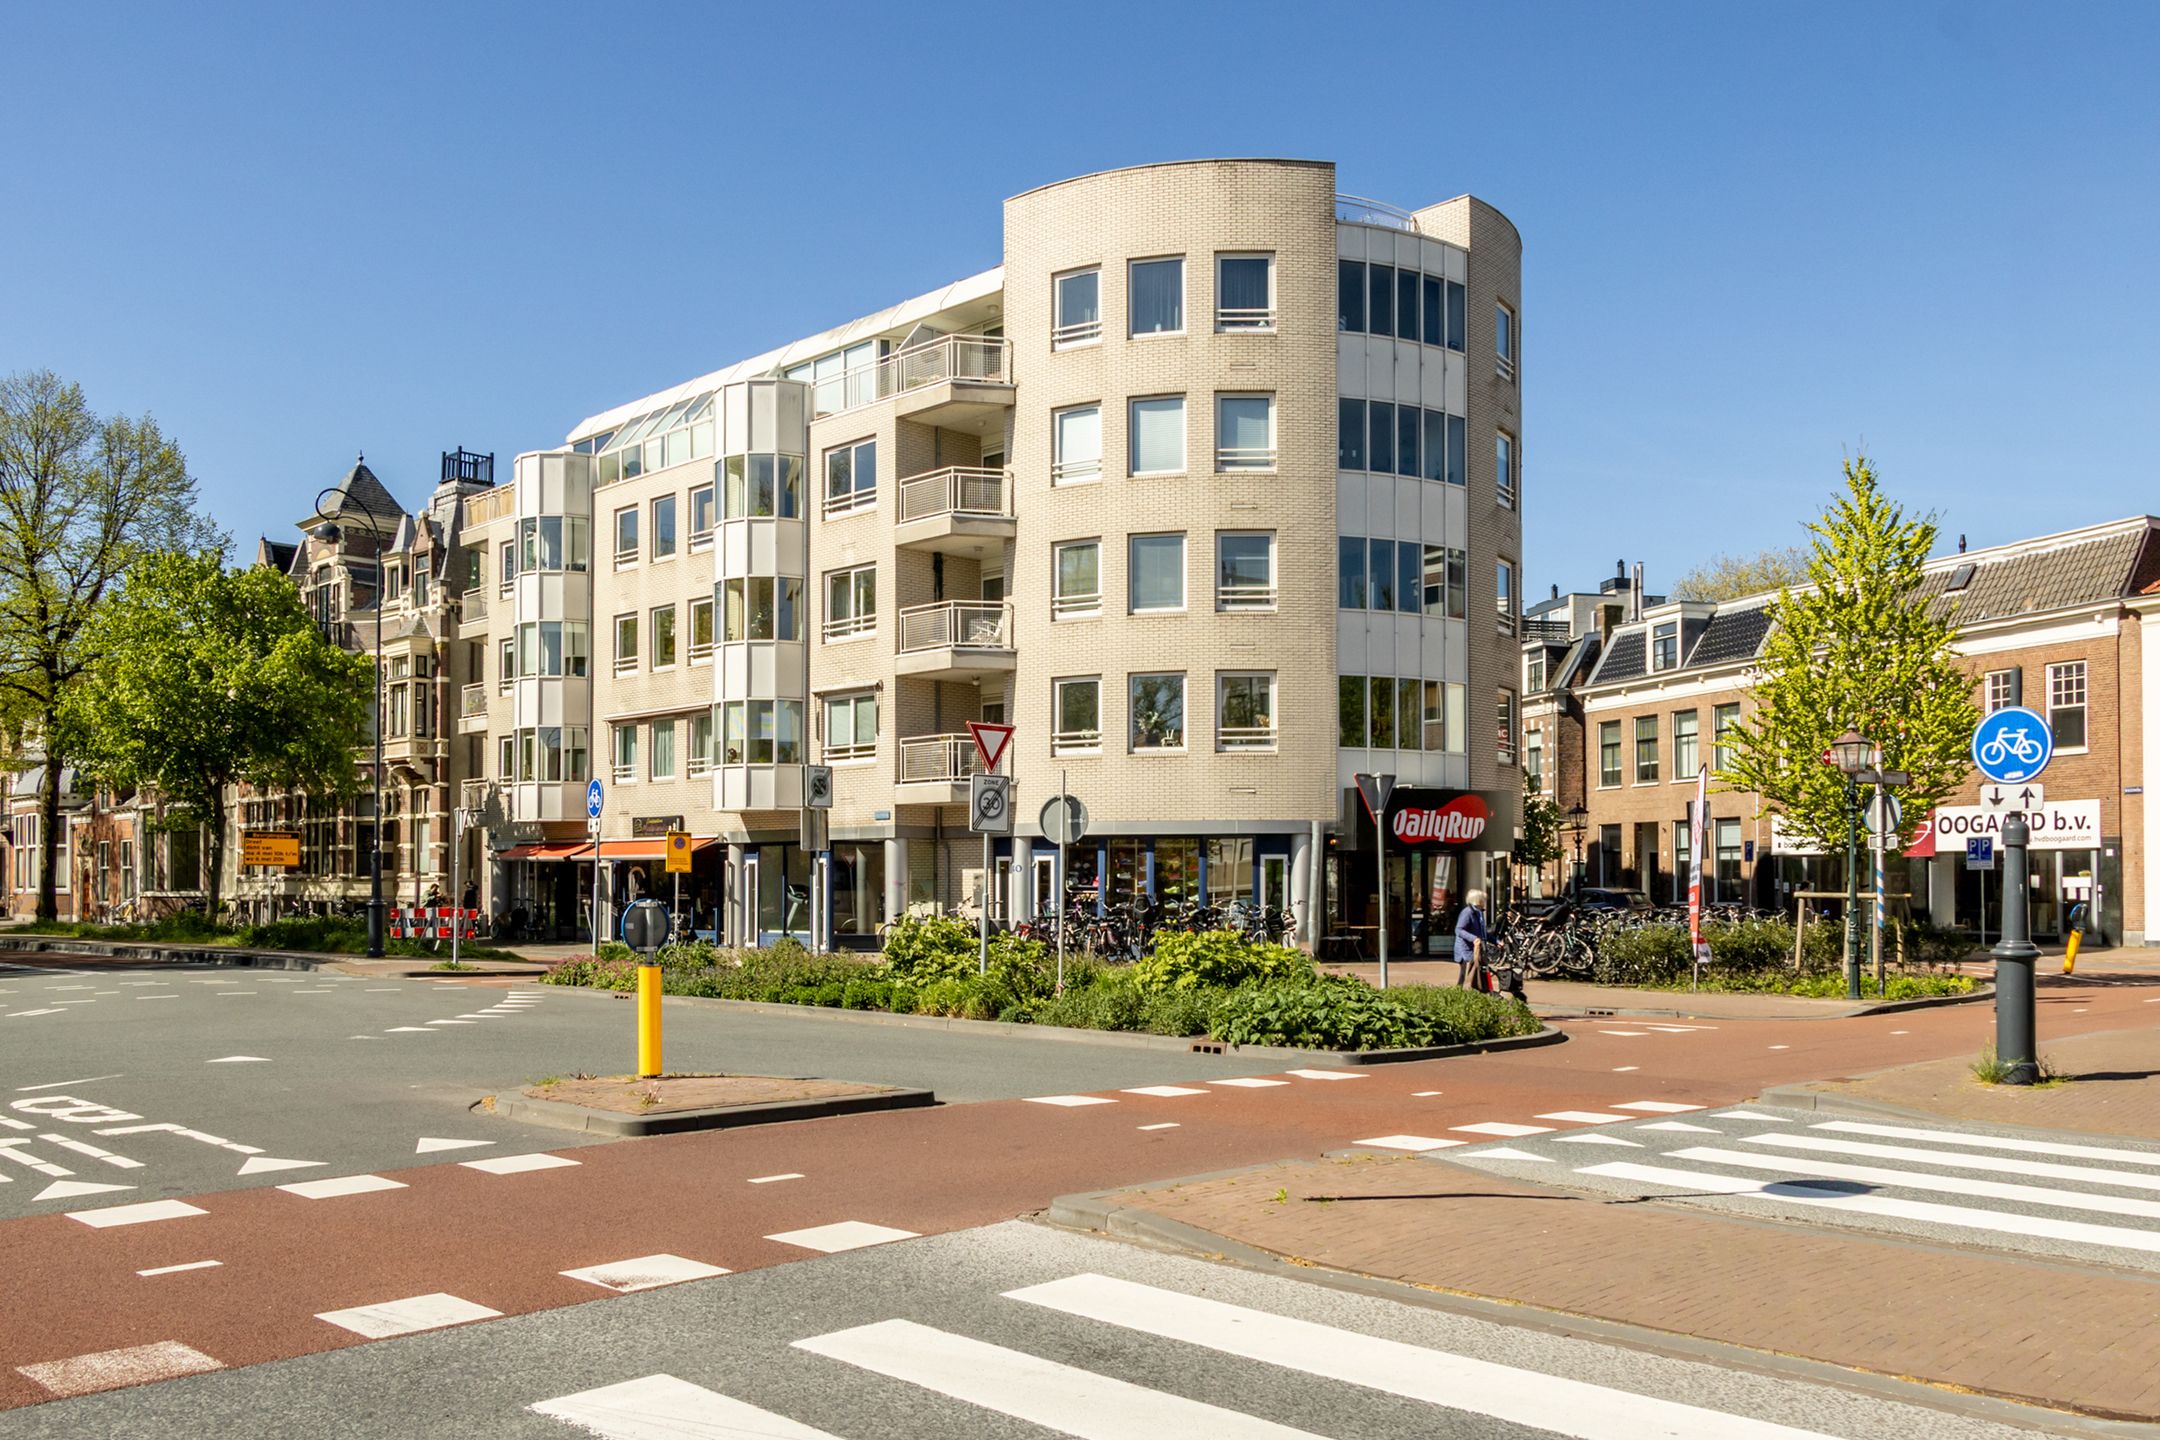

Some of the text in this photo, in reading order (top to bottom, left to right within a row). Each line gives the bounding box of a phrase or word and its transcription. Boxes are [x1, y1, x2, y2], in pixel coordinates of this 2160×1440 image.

[983, 796, 1000, 810] 30
[1393, 809, 1485, 842] DailyRun
[2054, 810, 2091, 830] b.v.
[1970, 840, 1977, 851] P
[1982, 840, 1990, 851] P
